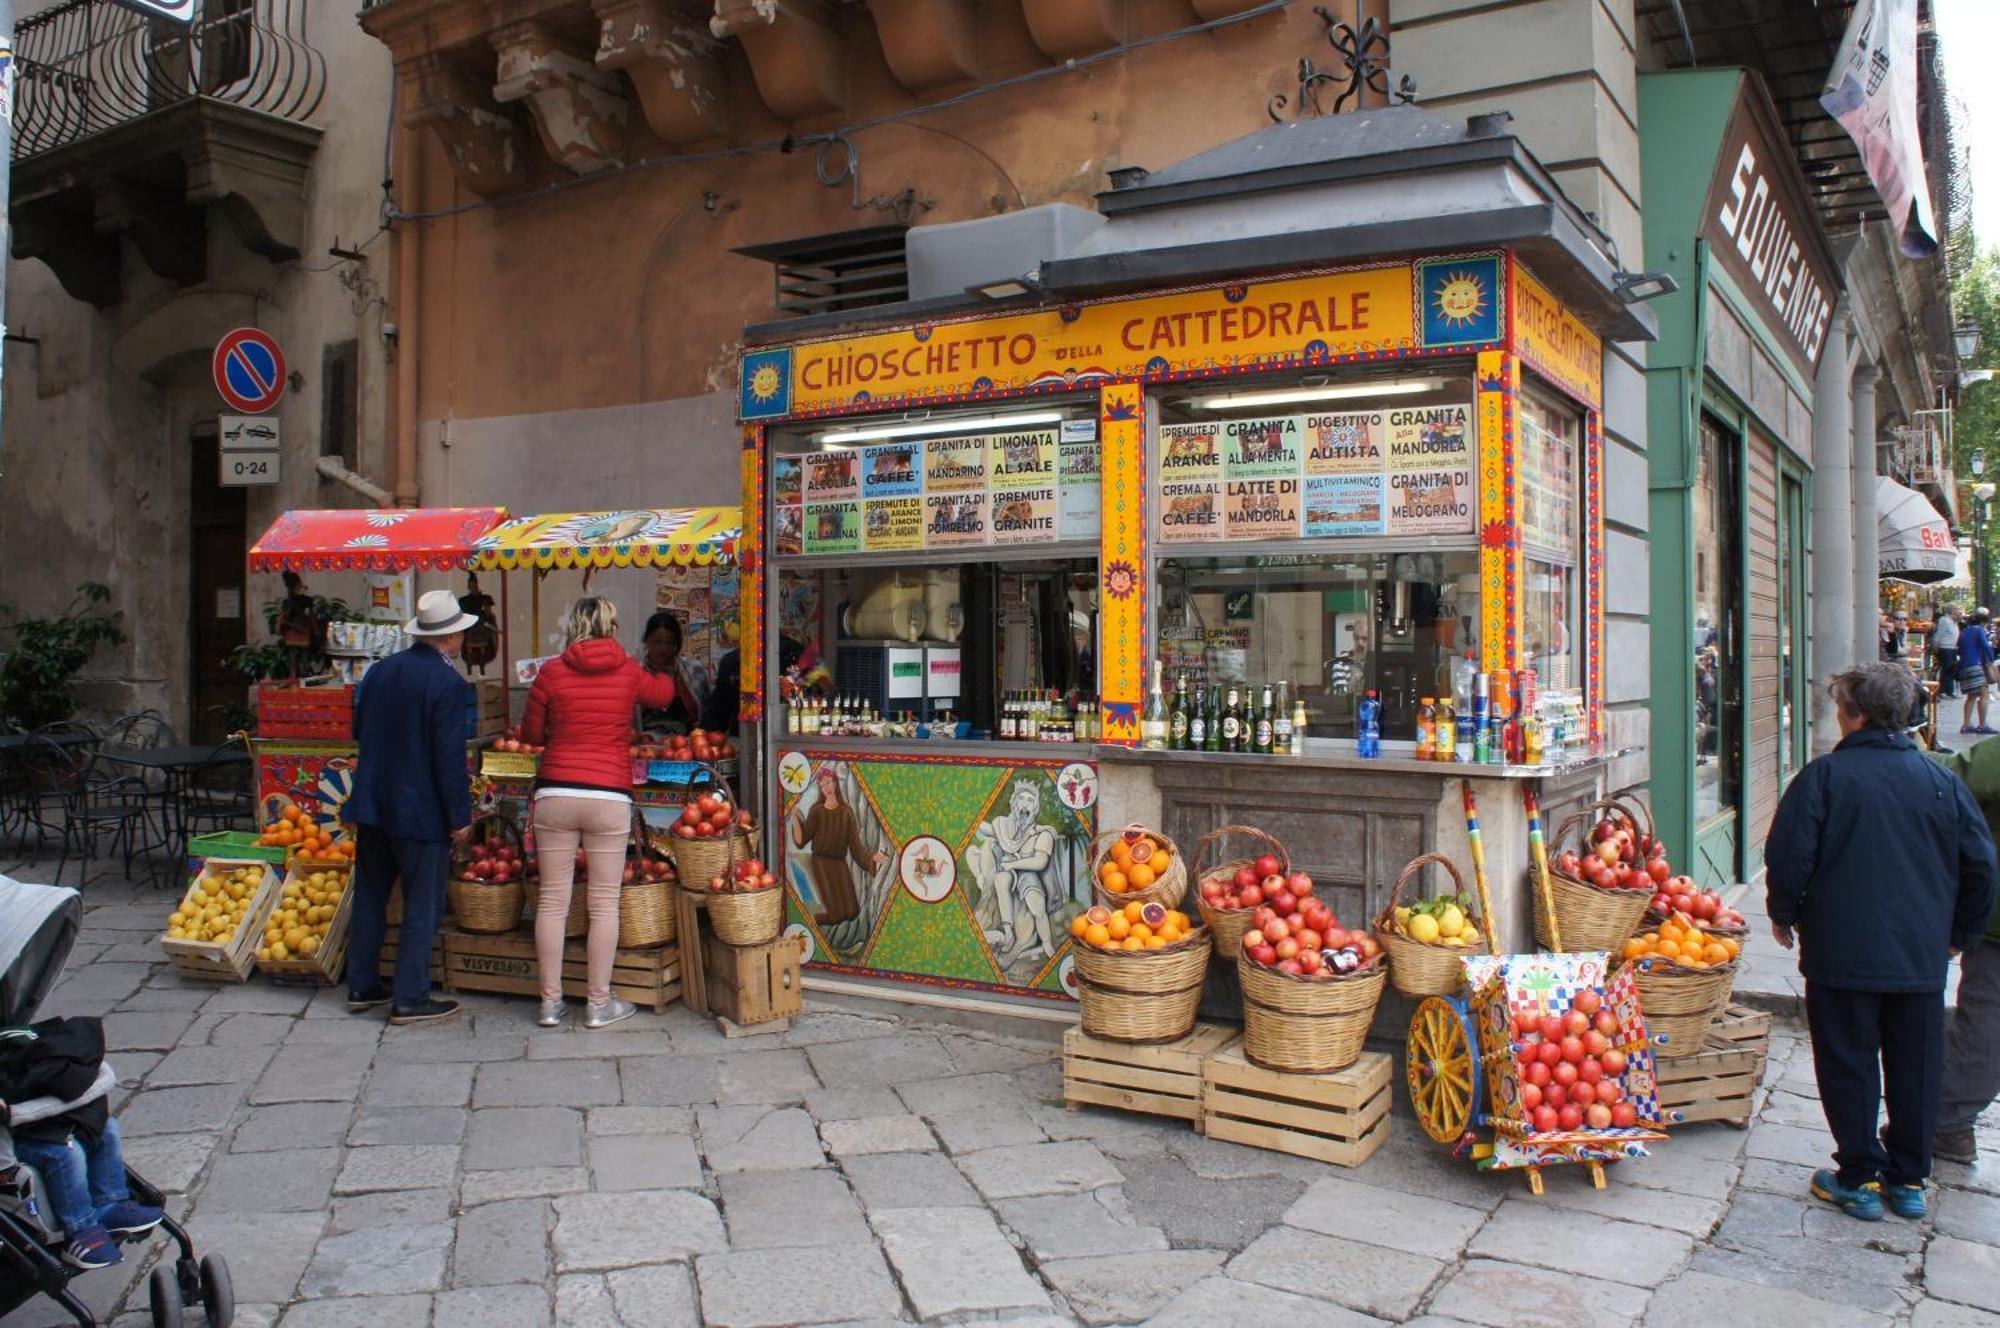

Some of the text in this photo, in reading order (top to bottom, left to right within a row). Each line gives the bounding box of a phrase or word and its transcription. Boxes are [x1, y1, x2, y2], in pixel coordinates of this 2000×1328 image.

[1720, 142, 1829, 362] SOUVENIRS
[1055, 344, 1104, 361] DELLA
[1121, 292, 1371, 351] CATTEDRALE
[1307, 414, 1381, 428] DIGESTIVO
[1390, 408, 1467, 426] GRANITA
[1162, 424, 1220, 438] SPREMUTE DI
[1226, 420, 1296, 437] GRANITA
[927, 438, 985, 453] GRANITA DI
[992, 433, 1053, 449] LIMONATA
[1391, 439, 1467, 456] MANDORLA
[806, 450, 857, 465] GRANITA
[1060, 446, 1094, 456] GRANITA
[1228, 449, 1296, 465] ALLA MENTA
[1309, 445, 1380, 460] AUTISTA
[234, 462, 268, 475] 0-24
[994, 461, 1053, 475] AL SALE
[1162, 453, 1220, 469] ARANCE
[928, 465, 985, 479] MANDARINO
[1306, 476, 1380, 489] MULTIVITAMINICO
[1391, 471, 1469, 489] GRANITA DI
[1162, 483, 1221, 496] CREMA AL
[1228, 480, 1297, 496] LATTE DI
[866, 498, 920, 510] SPREMUTE DI
[927, 493, 985, 508] GRANITA DI
[993, 490, 1053, 504] SPREMUTE
[806, 502, 858, 515] GRANITA
[891, 508, 922, 517] ARANCE
[1228, 509, 1296, 522] MANDORLA
[1392, 503, 1468, 519] MELOGRANO
[890, 517, 922, 526] LIMONI
[928, 520, 984, 534] POMPELMO
[994, 516, 1053, 531] GRANITE
